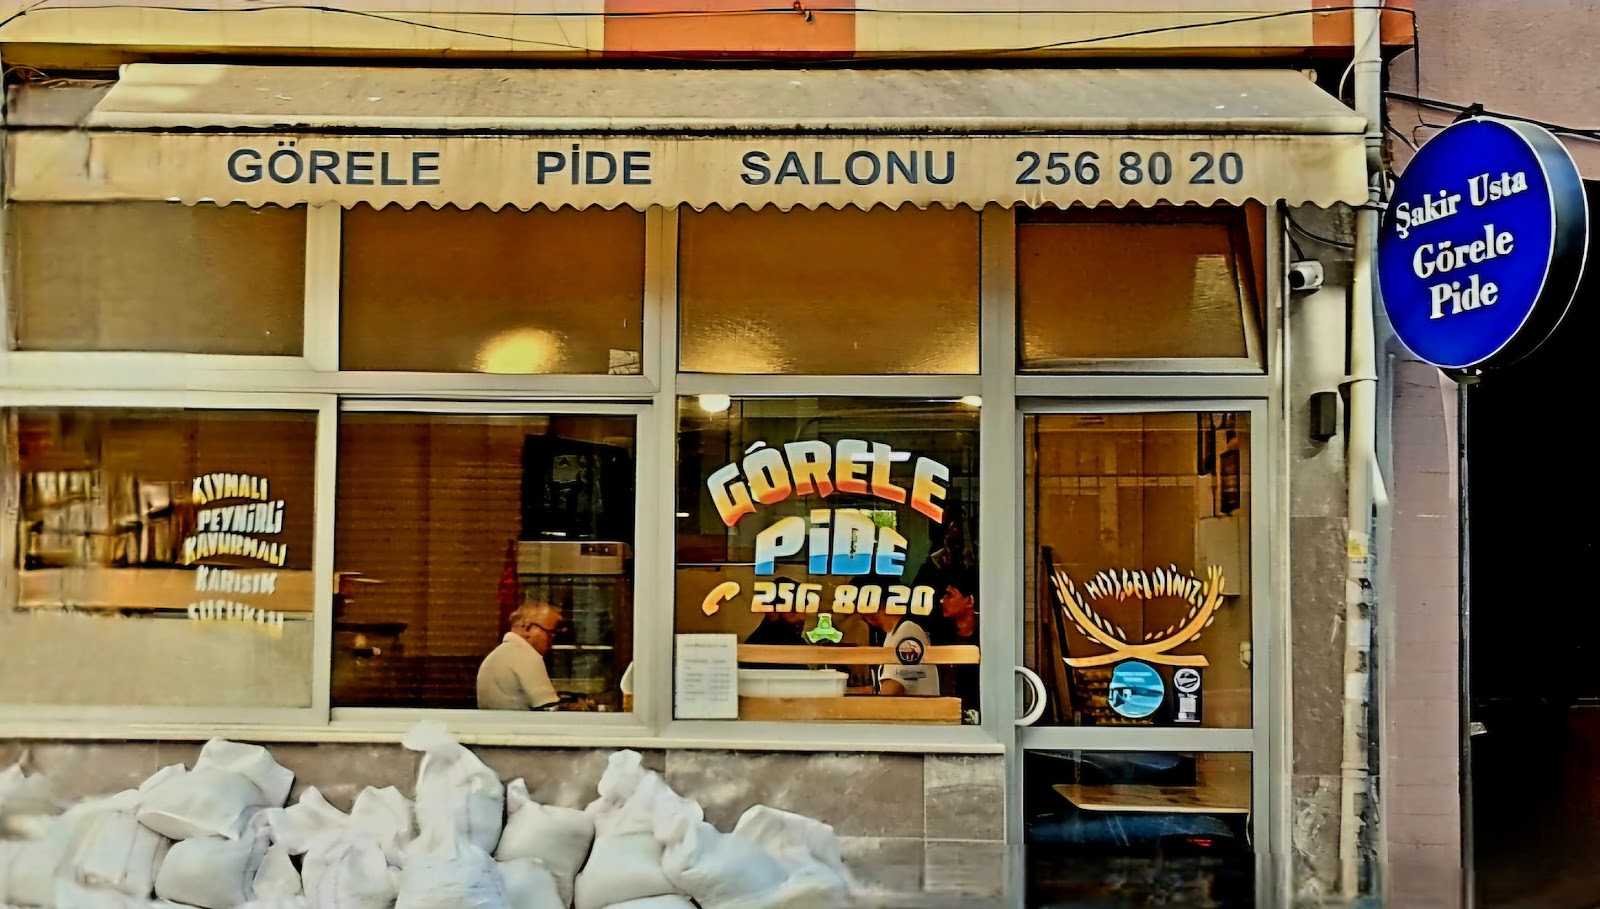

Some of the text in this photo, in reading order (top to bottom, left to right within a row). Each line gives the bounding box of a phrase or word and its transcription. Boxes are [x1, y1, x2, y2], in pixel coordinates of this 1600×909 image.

[227, 141, 1245, 186] GÖRELE PİDE SALONU 256 80 20
[1396, 172, 1529, 240] Şakir Usta
[1412, 223, 1515, 279] Görele
[1429, 273, 1499, 320] Pide
[192, 472, 269, 505] KIYMALI
[750, 581, 936, 616] 256 80 20
